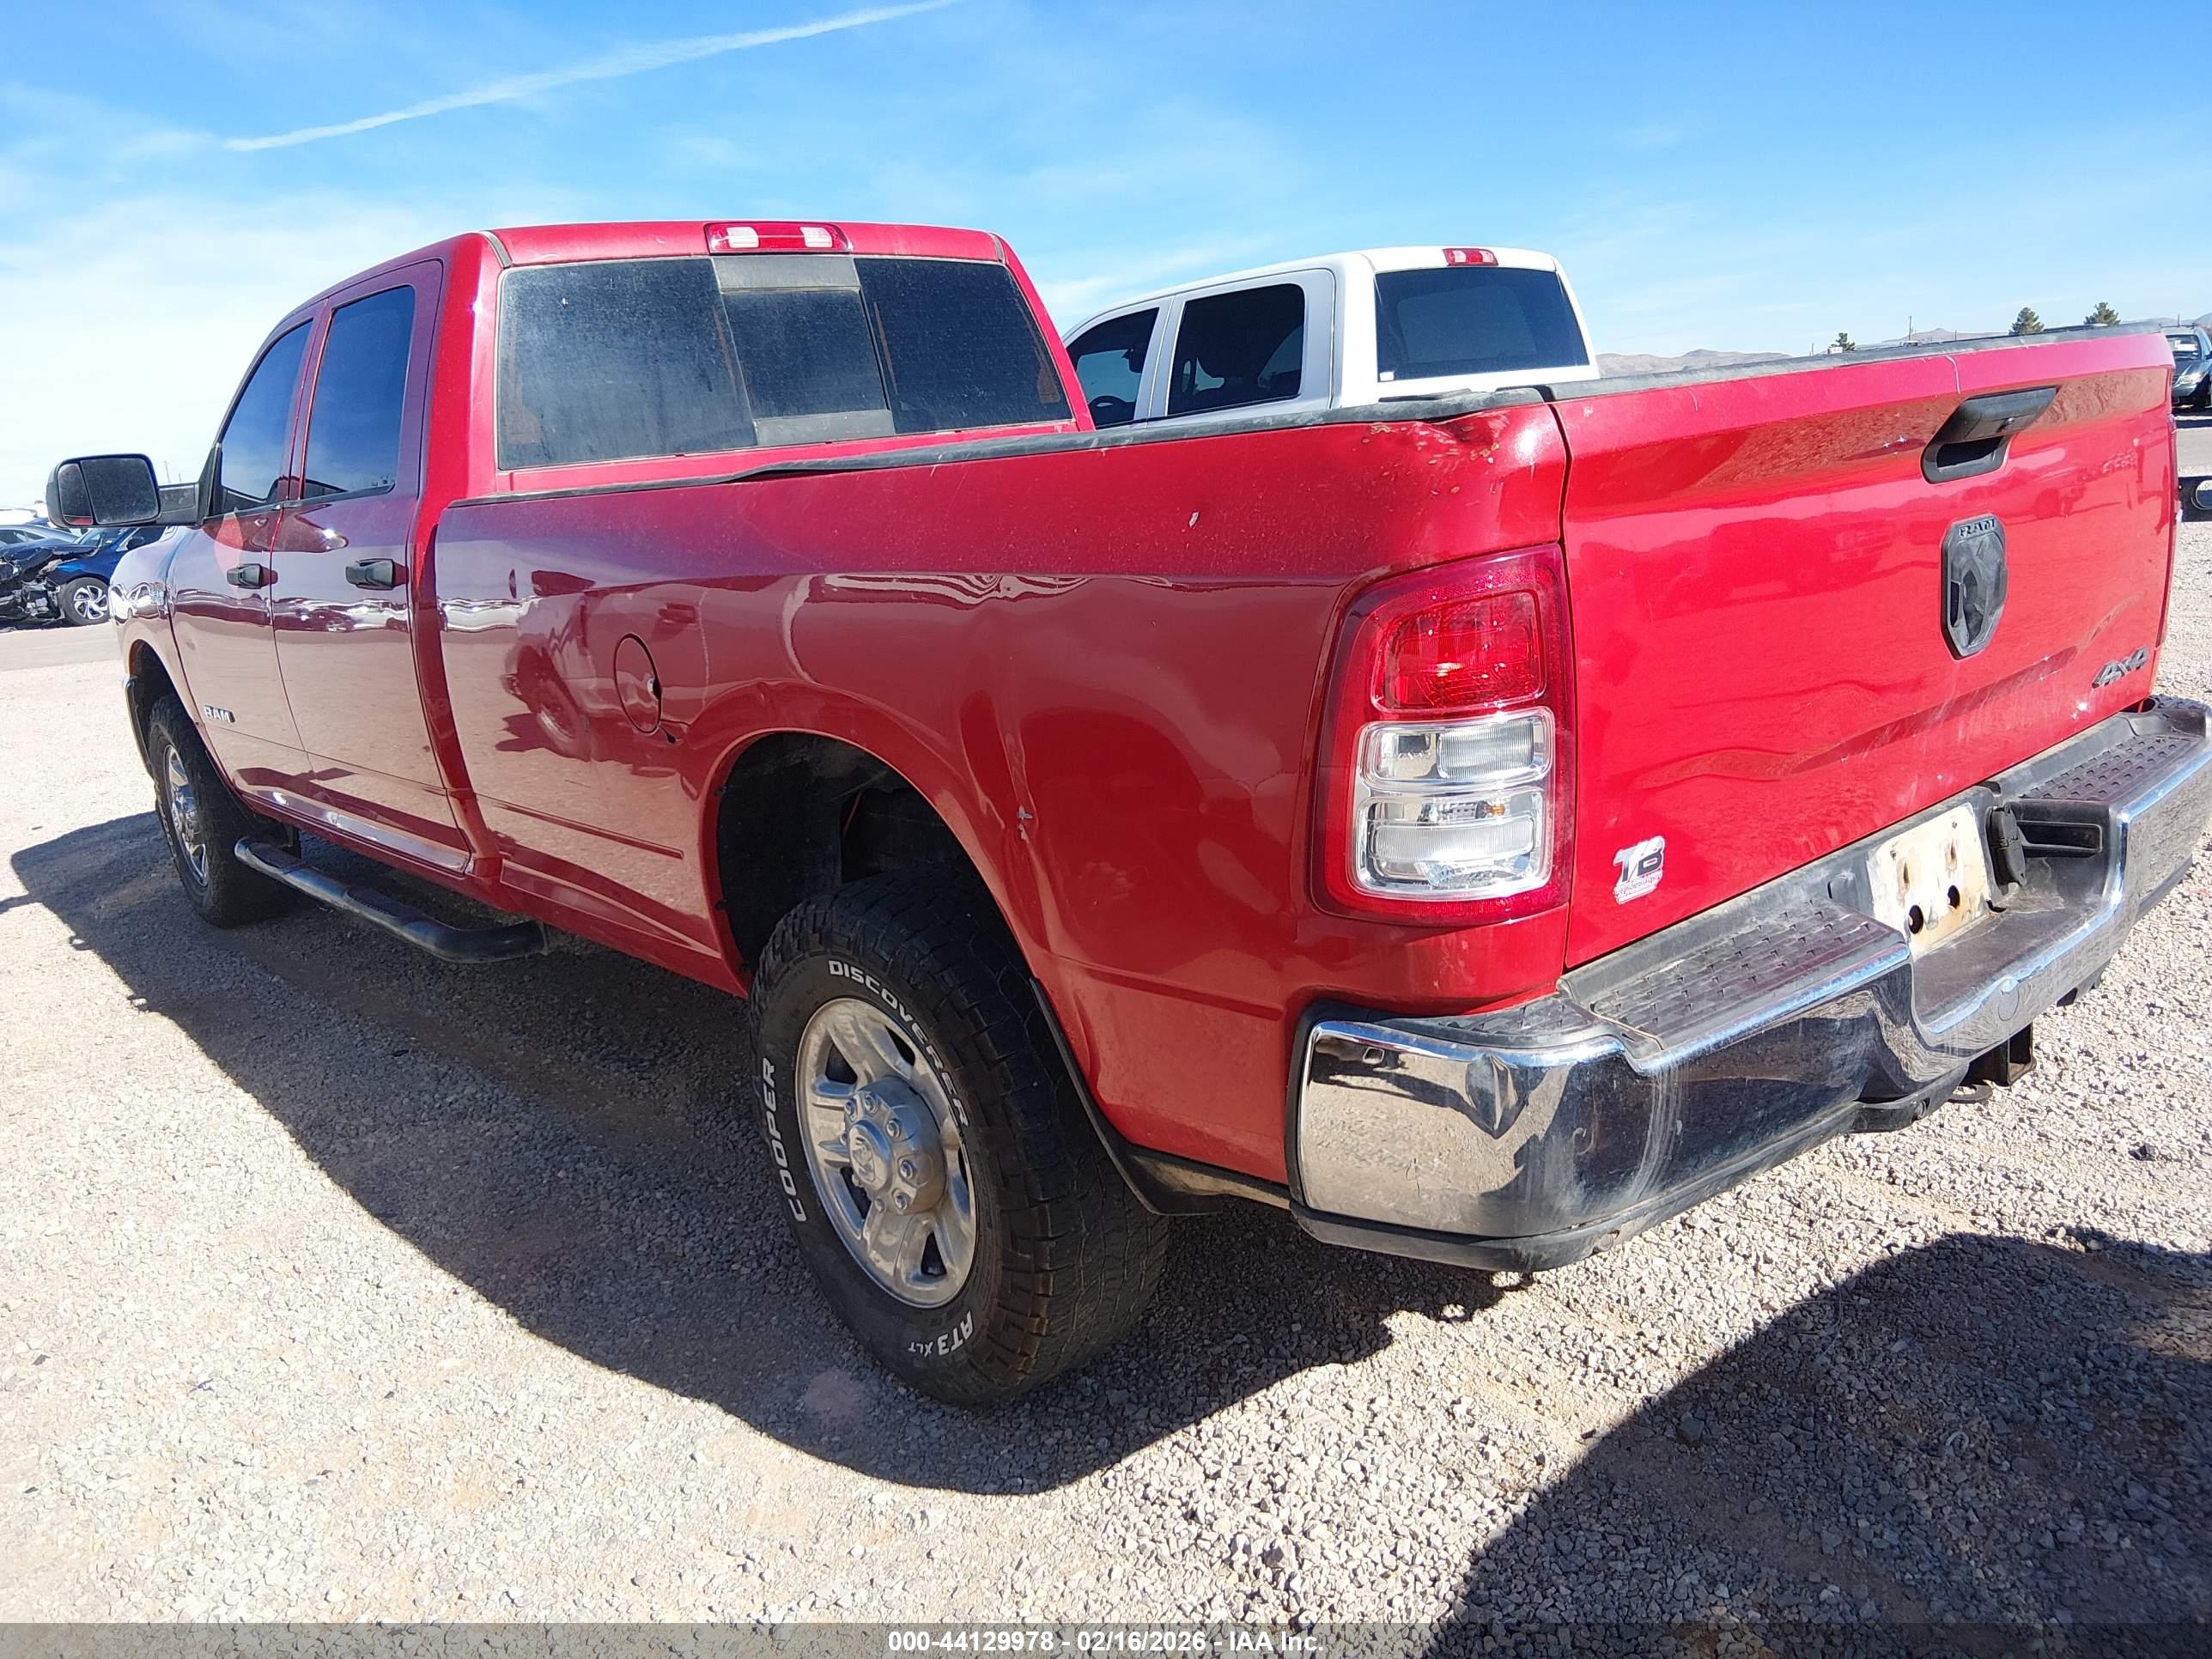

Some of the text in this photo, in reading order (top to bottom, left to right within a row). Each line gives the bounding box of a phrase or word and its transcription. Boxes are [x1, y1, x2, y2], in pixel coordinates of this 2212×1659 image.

[1959, 518, 1995, 538] RAM
[204, 704, 234, 723] RAM
[828, 959, 970, 1127] DISCOVERER
[762, 1056, 808, 1223] COOPER
[907, 1310, 974, 1358] AT3 XLT
